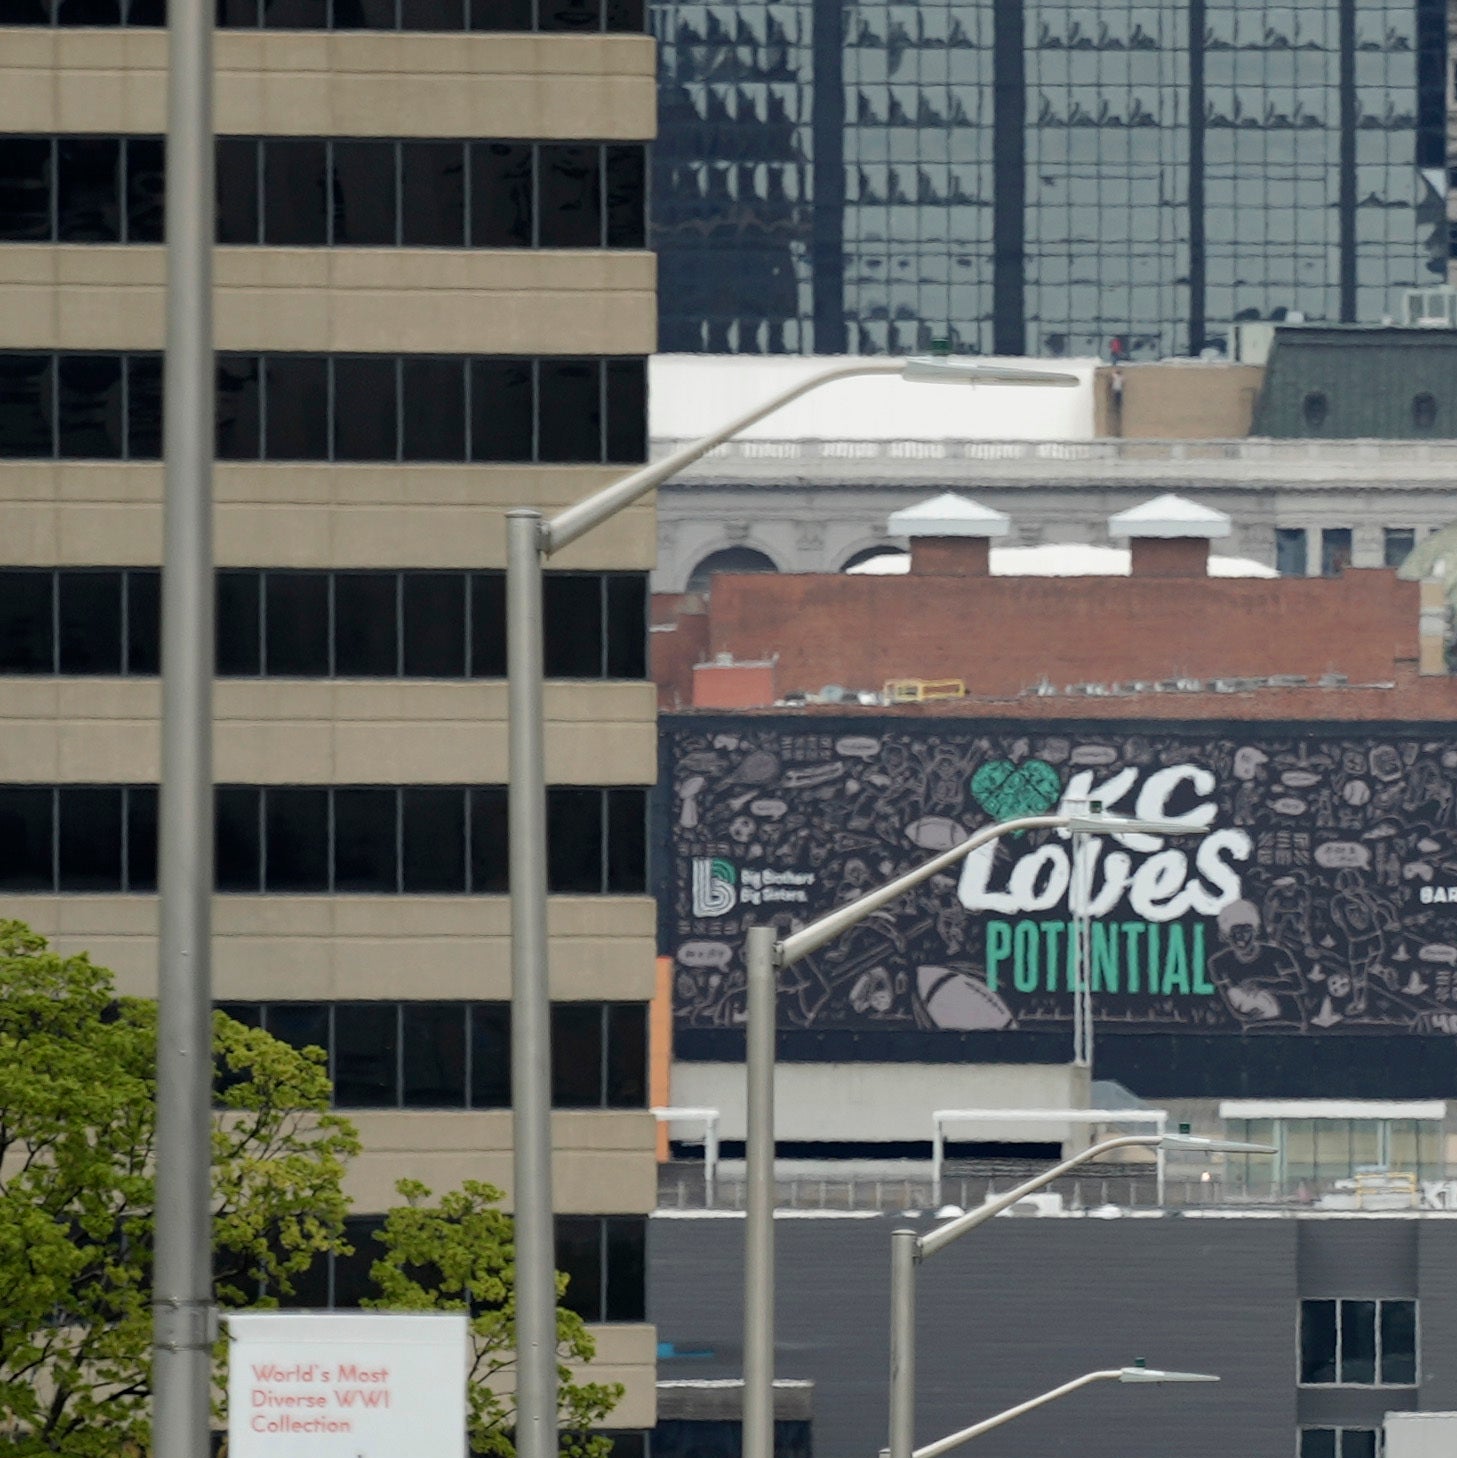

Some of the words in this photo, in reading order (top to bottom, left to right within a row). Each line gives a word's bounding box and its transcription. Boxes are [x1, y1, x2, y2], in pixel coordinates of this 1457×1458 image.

[1057, 764, 1218, 852] KC
[986, 919, 1215, 995] POTENTIAL
[337, 1364, 389, 1384] Most
[252, 1390, 326, 1408] Diverse
[334, 1390, 390, 1409] WWI
[251, 1415, 352, 1433] Collection
